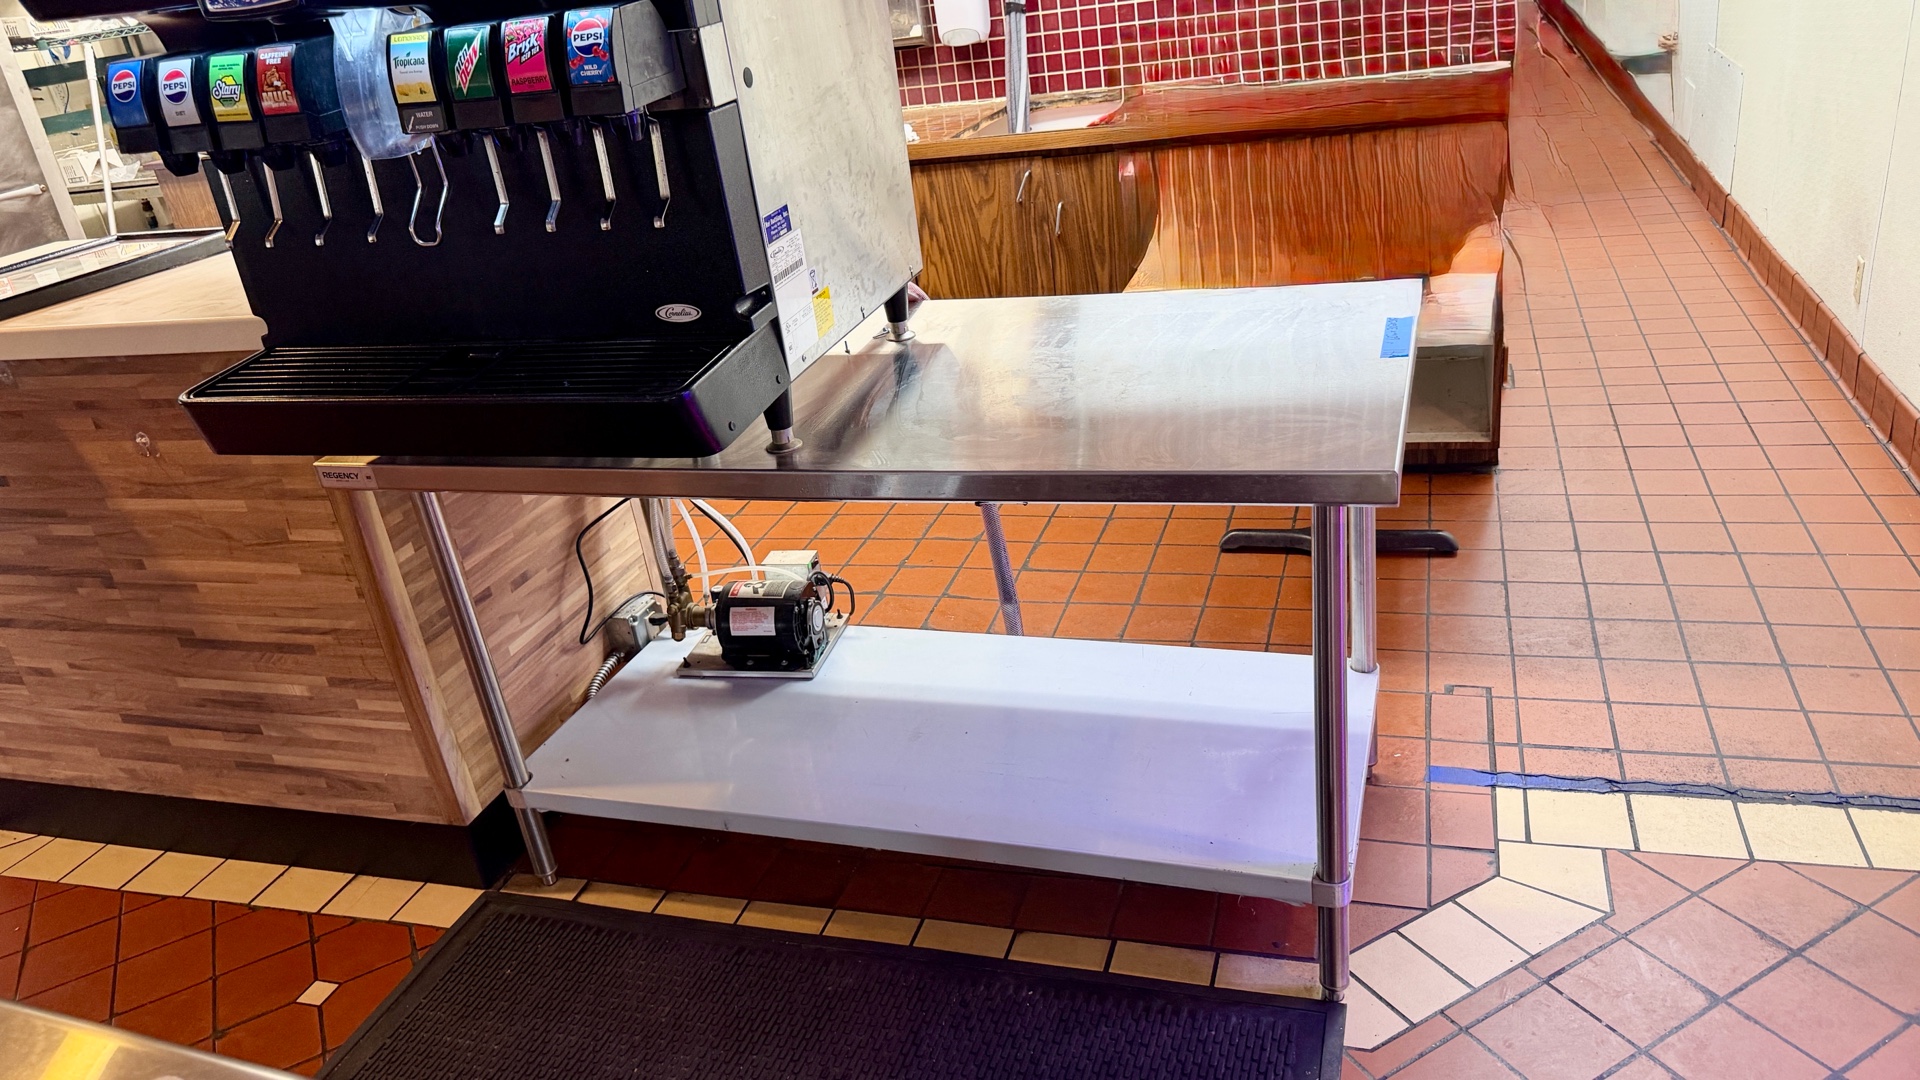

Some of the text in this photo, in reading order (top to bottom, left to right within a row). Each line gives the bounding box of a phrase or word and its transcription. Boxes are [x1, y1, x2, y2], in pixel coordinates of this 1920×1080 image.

[573, 32, 602, 42] PEPSI
[260, 51, 289, 60] CAFFEINE
[393, 56, 426, 69] Tropicana
[113, 81, 135, 90] PEPSI
[511, 75, 547, 86] RASPBERRY
[163, 81, 187, 91] PEPSI
[212, 80, 241, 101] Starry
[262, 89, 293, 104] MUG
[415, 110, 434, 118] WATER
[665, 306, 692, 318] Cornelius
[322, 471, 359, 480] REGENCY
